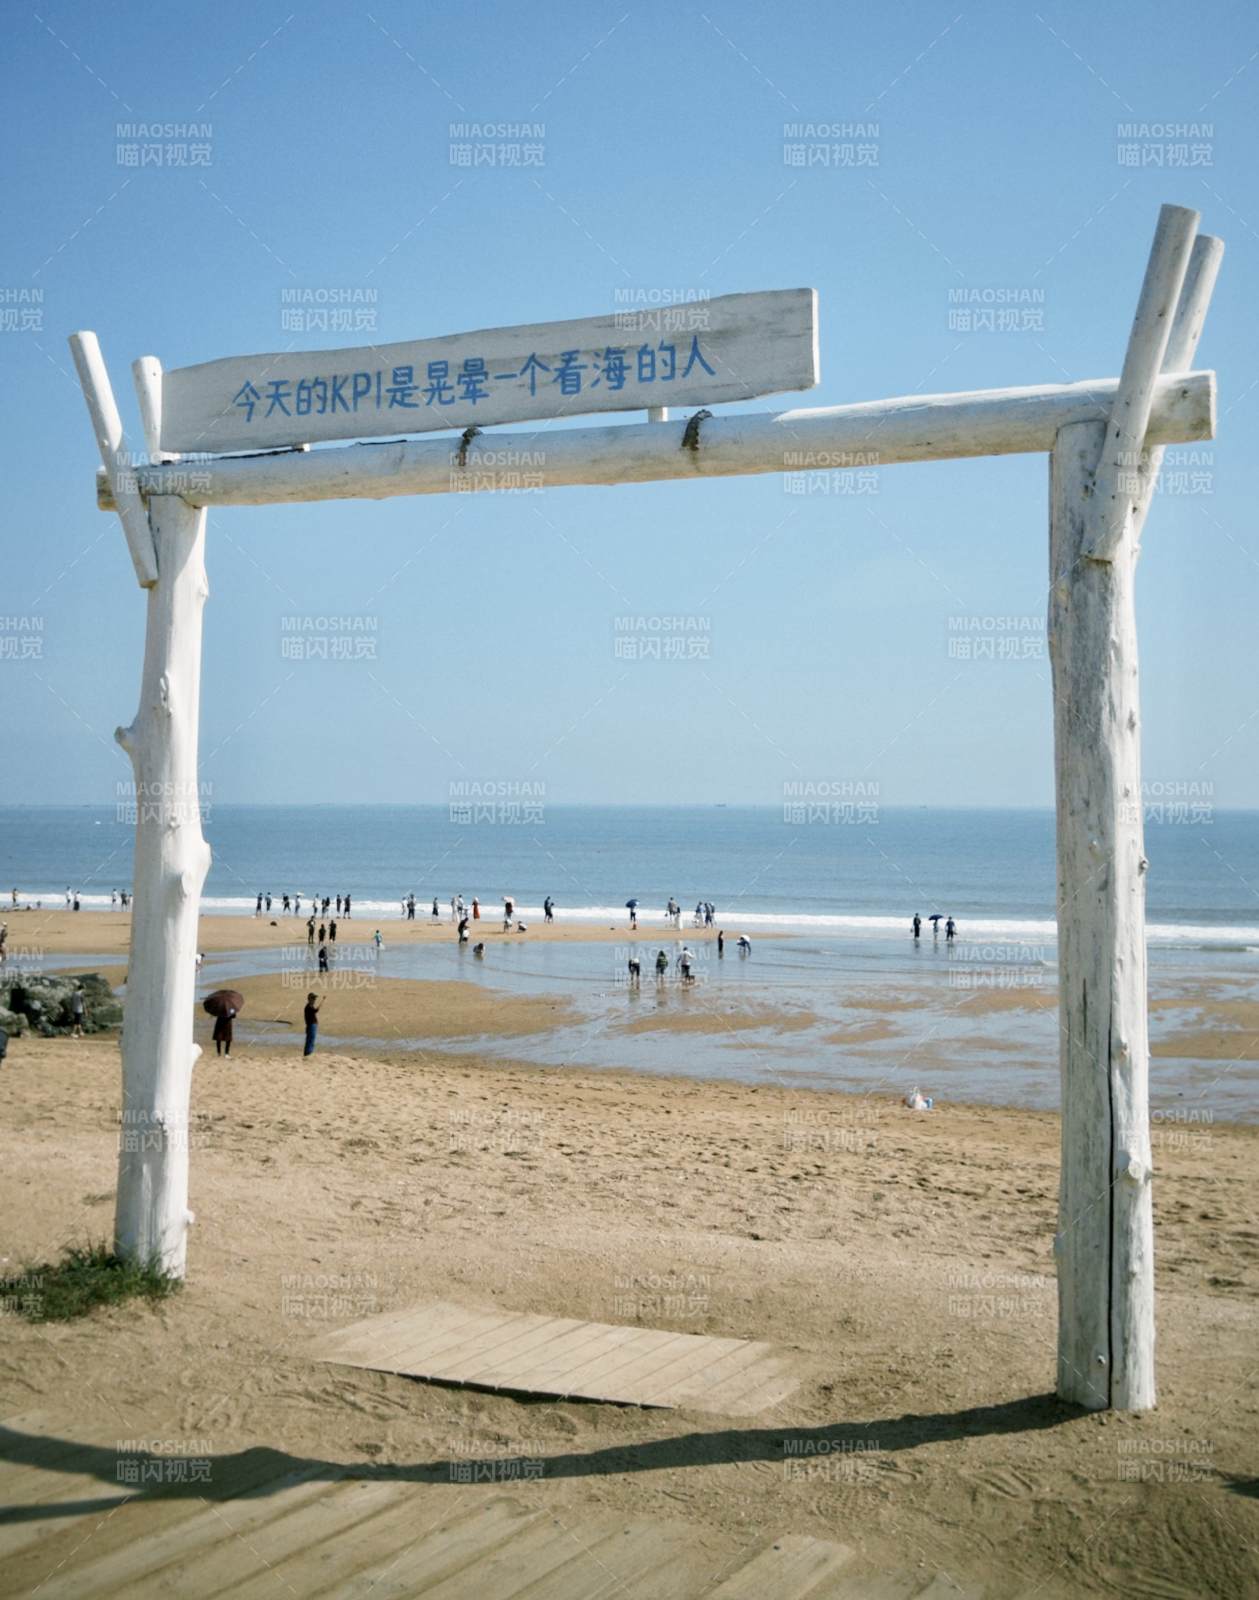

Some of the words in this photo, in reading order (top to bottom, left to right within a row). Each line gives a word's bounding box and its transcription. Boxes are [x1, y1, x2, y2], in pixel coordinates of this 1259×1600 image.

[232, 335, 716, 423] 今天的KPI是晃晕一个看海的人
